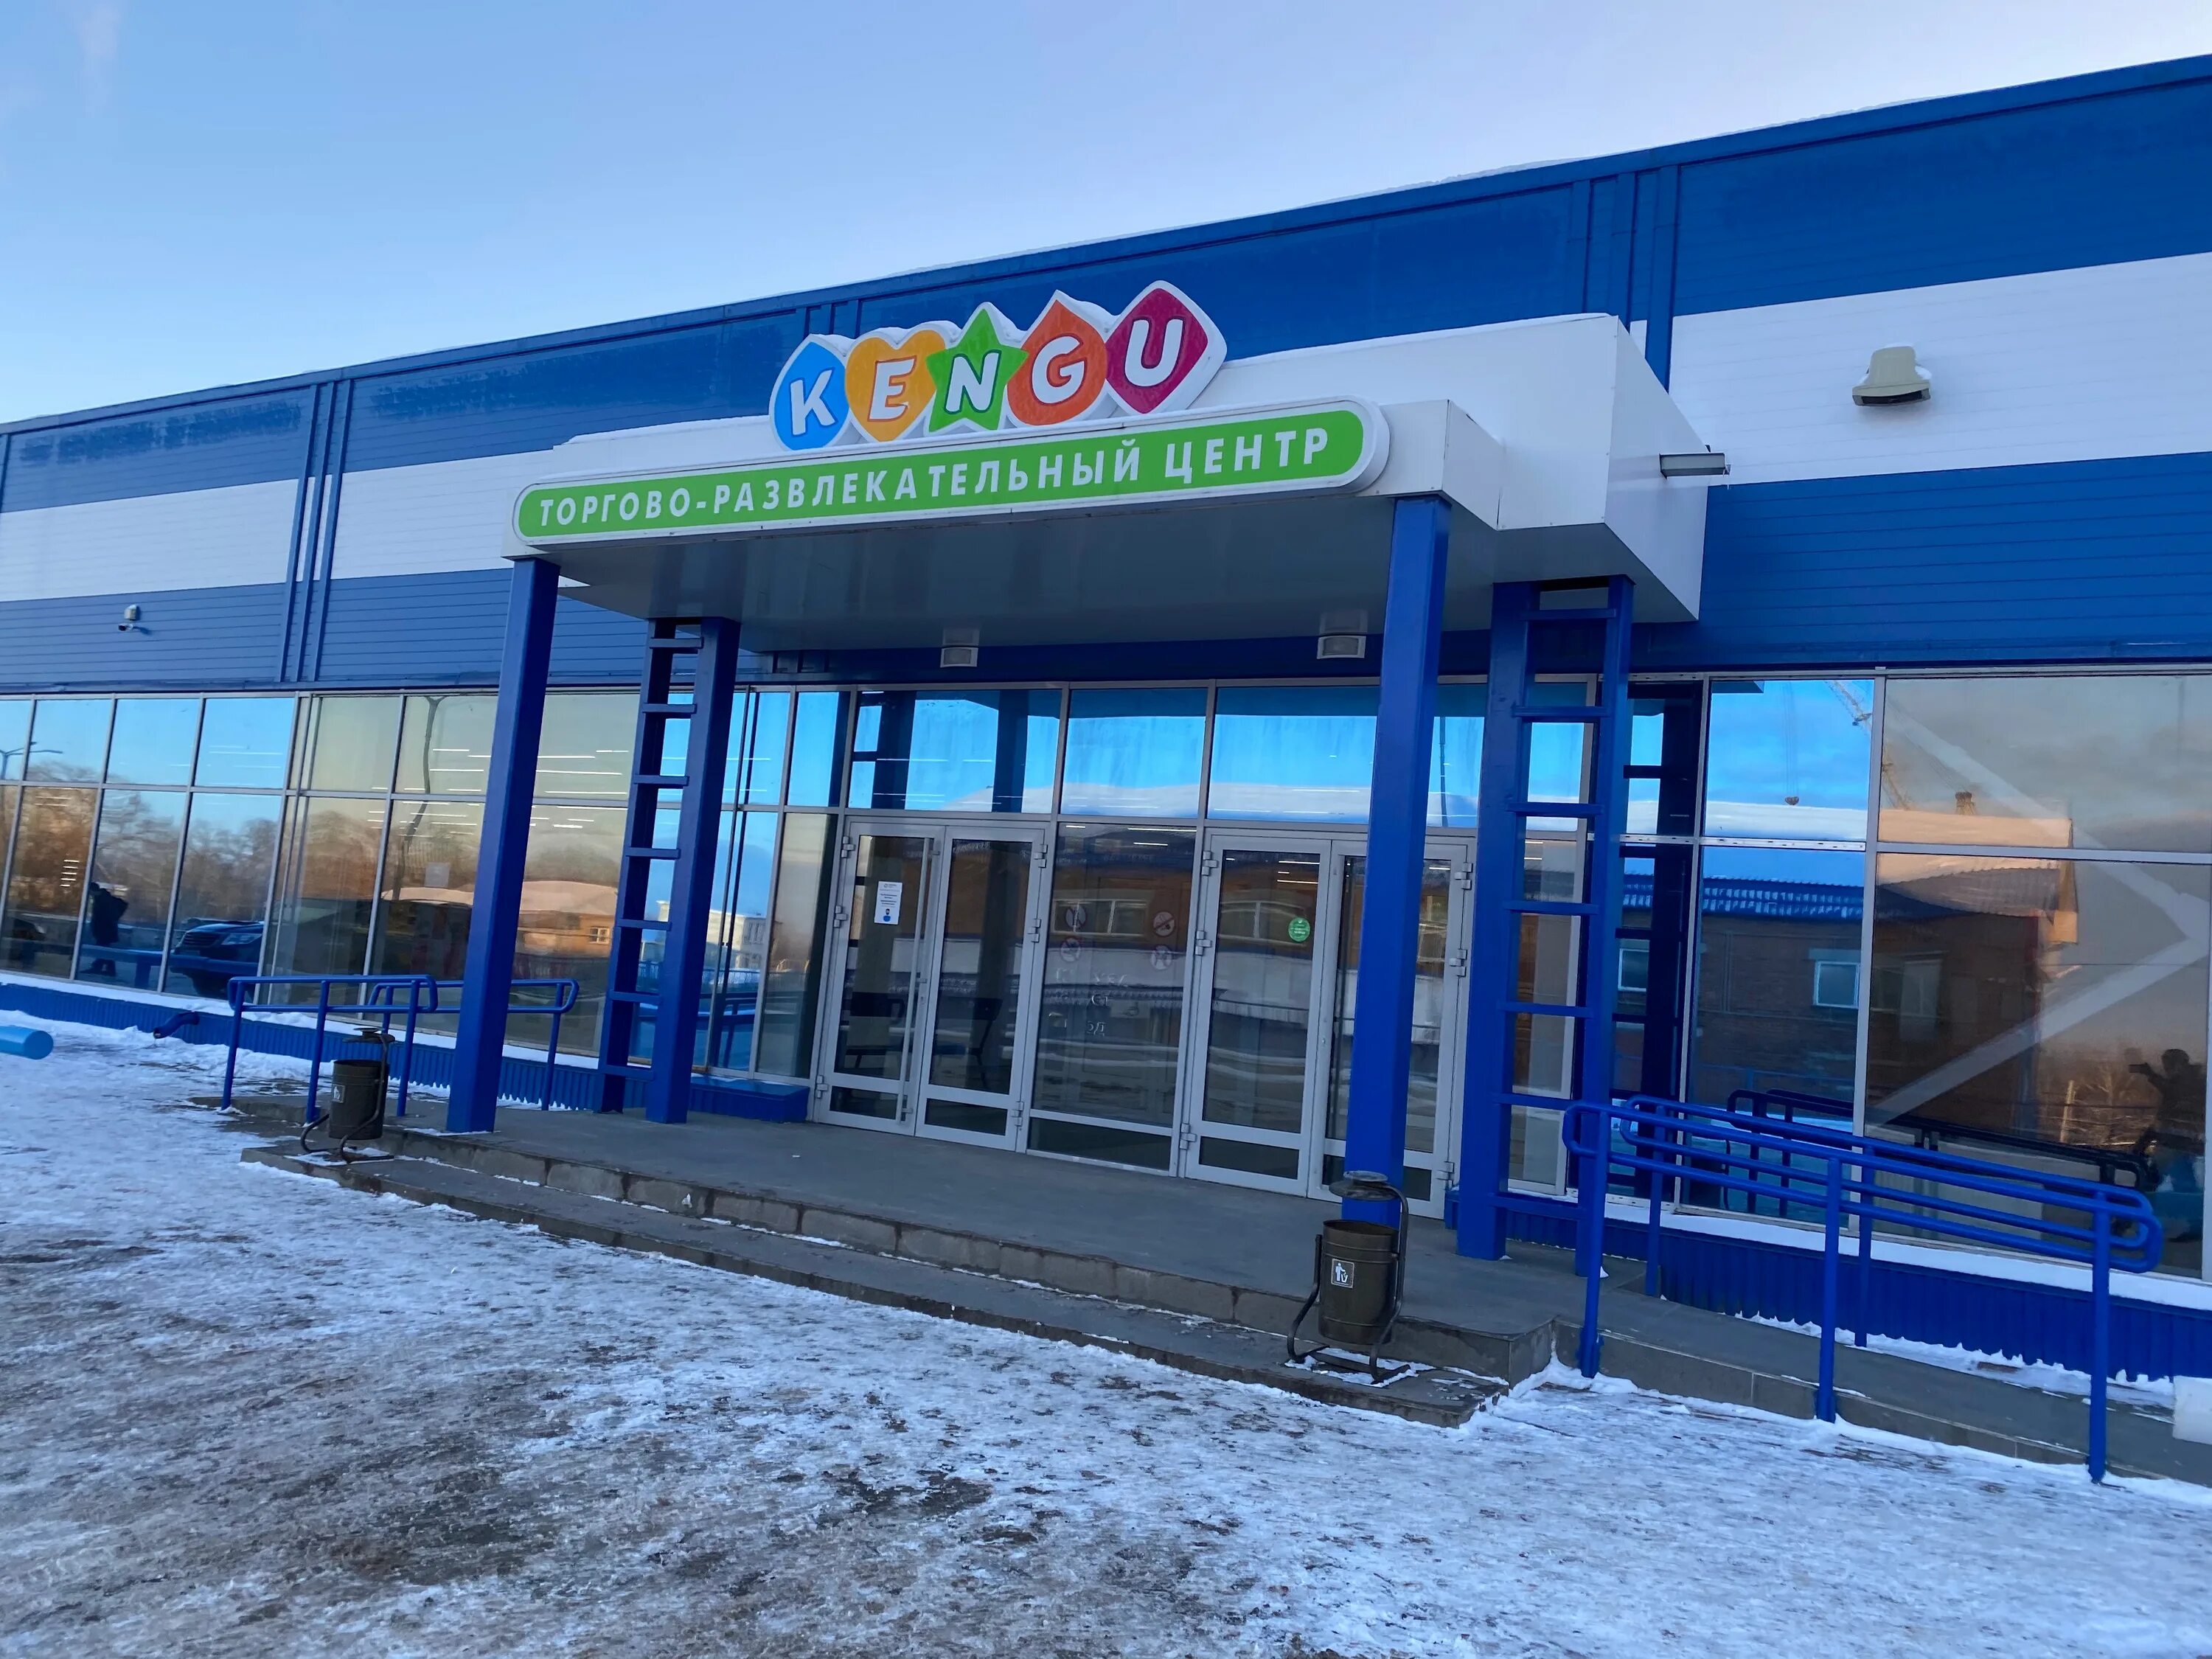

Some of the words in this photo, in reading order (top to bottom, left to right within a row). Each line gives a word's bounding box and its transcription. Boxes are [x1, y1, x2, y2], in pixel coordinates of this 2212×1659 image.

[789, 316, 1185, 437] KENGU
[539, 438, 1141, 526] ТОРГОВО-РАЗВЛЕКАТЕЛЬНЫЙ
[1164, 427, 1329, 484] ЦЕНТР
